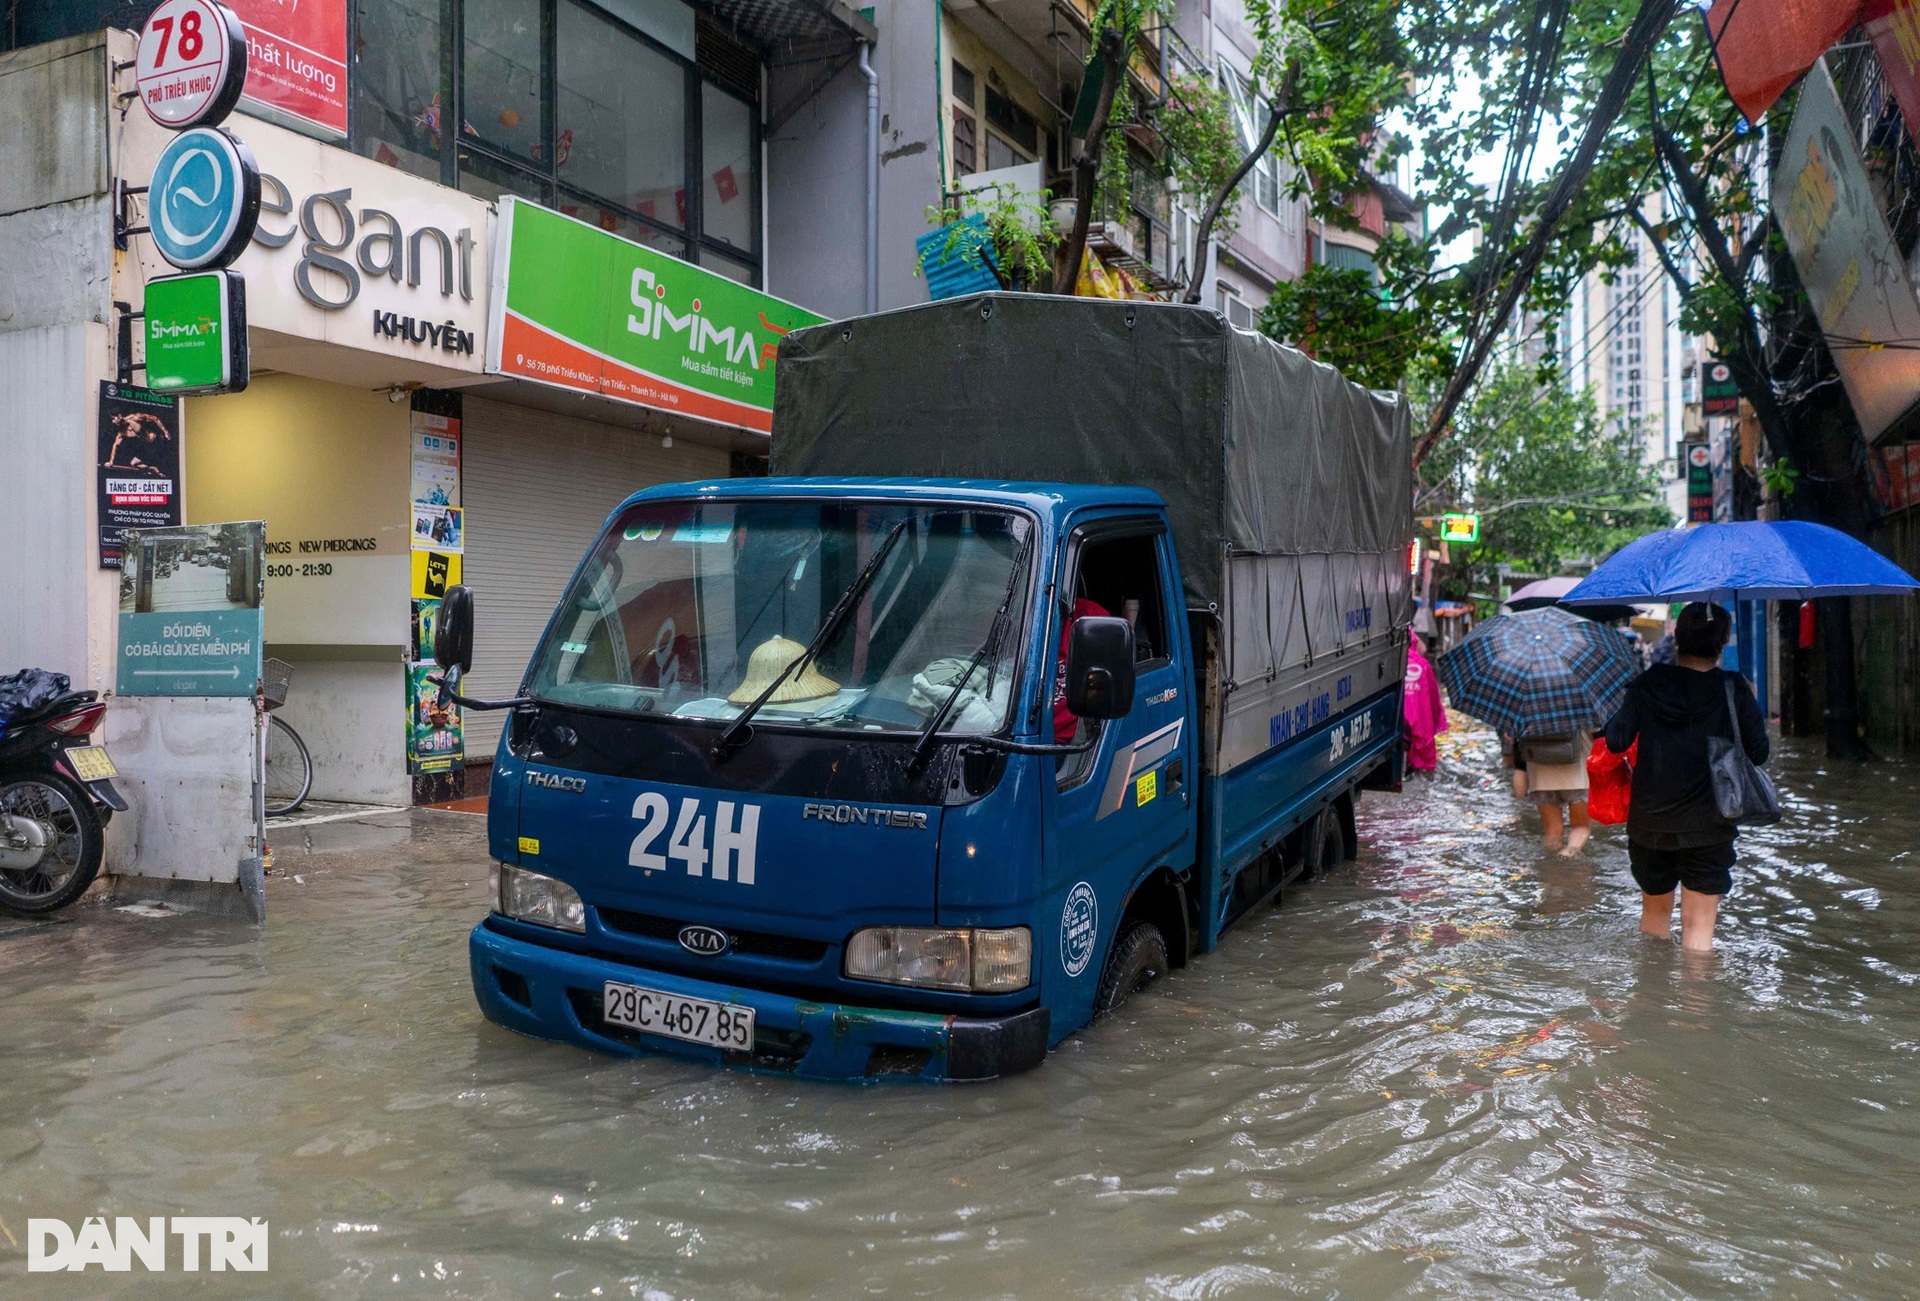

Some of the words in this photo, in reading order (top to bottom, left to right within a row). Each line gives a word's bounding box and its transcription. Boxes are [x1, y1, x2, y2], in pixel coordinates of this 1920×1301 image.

[152, 10, 203, 69] 78
[286, 51, 336, 93] lượng
[148, 82, 162, 104] PHỐ
[165, 77, 186, 100] TRIỀU
[189, 74, 211, 95] KHÚC
[373, 309, 474, 355] KHUYÊN
[526, 359, 537, 369] Số
[537, 361, 546, 371] 78
[546, 364, 561, 375] phố
[560, 366, 578, 379] Triều
[578, 370, 595, 383] Khúc
[599, 376, 611, 387] Tân
[611, 378, 627, 391] Triều
[630, 385, 649, 396] Thanh
[649, 388, 657, 398] Trì
[660, 391, 669, 401] Hà
[681, 356, 700, 370] Mua
[701, 361, 719, 377] sắm
[719, 367, 733, 381] tiết
[734, 371, 754, 387] kiệm
[135, 392, 173, 404] FITNESS
[109, 481, 127, 492] TĂNG
[128, 483, 138, 492] CƠ
[143, 480, 155, 492] CẮT
[157, 482, 169, 492] NÉT
[299, 540, 322, 553] NEW
[323, 537, 377, 552] PIERCINGS
[267, 564, 293, 577] 9:00
[302, 563, 332, 576] 21:30
[429, 560, 447, 571] LET'S
[163, 621, 183, 637] ĐỐI
[184, 622, 211, 640] DIỆN
[125, 642, 141, 656] CÓ
[142, 642, 161, 656] BÃI
[162, 640, 182, 656] GỬI
[183, 644, 199, 656] XE
[200, 638, 229, 656] MIỄN
[230, 639, 250, 655] PHÍ
[526, 770, 587, 793] THACO
[803, 803, 927, 830] FRONTIER
[628, 792, 761, 885] 24H
[686, 931, 719, 951] KIA
[608, 988, 748, 1045] 29C-467.85
